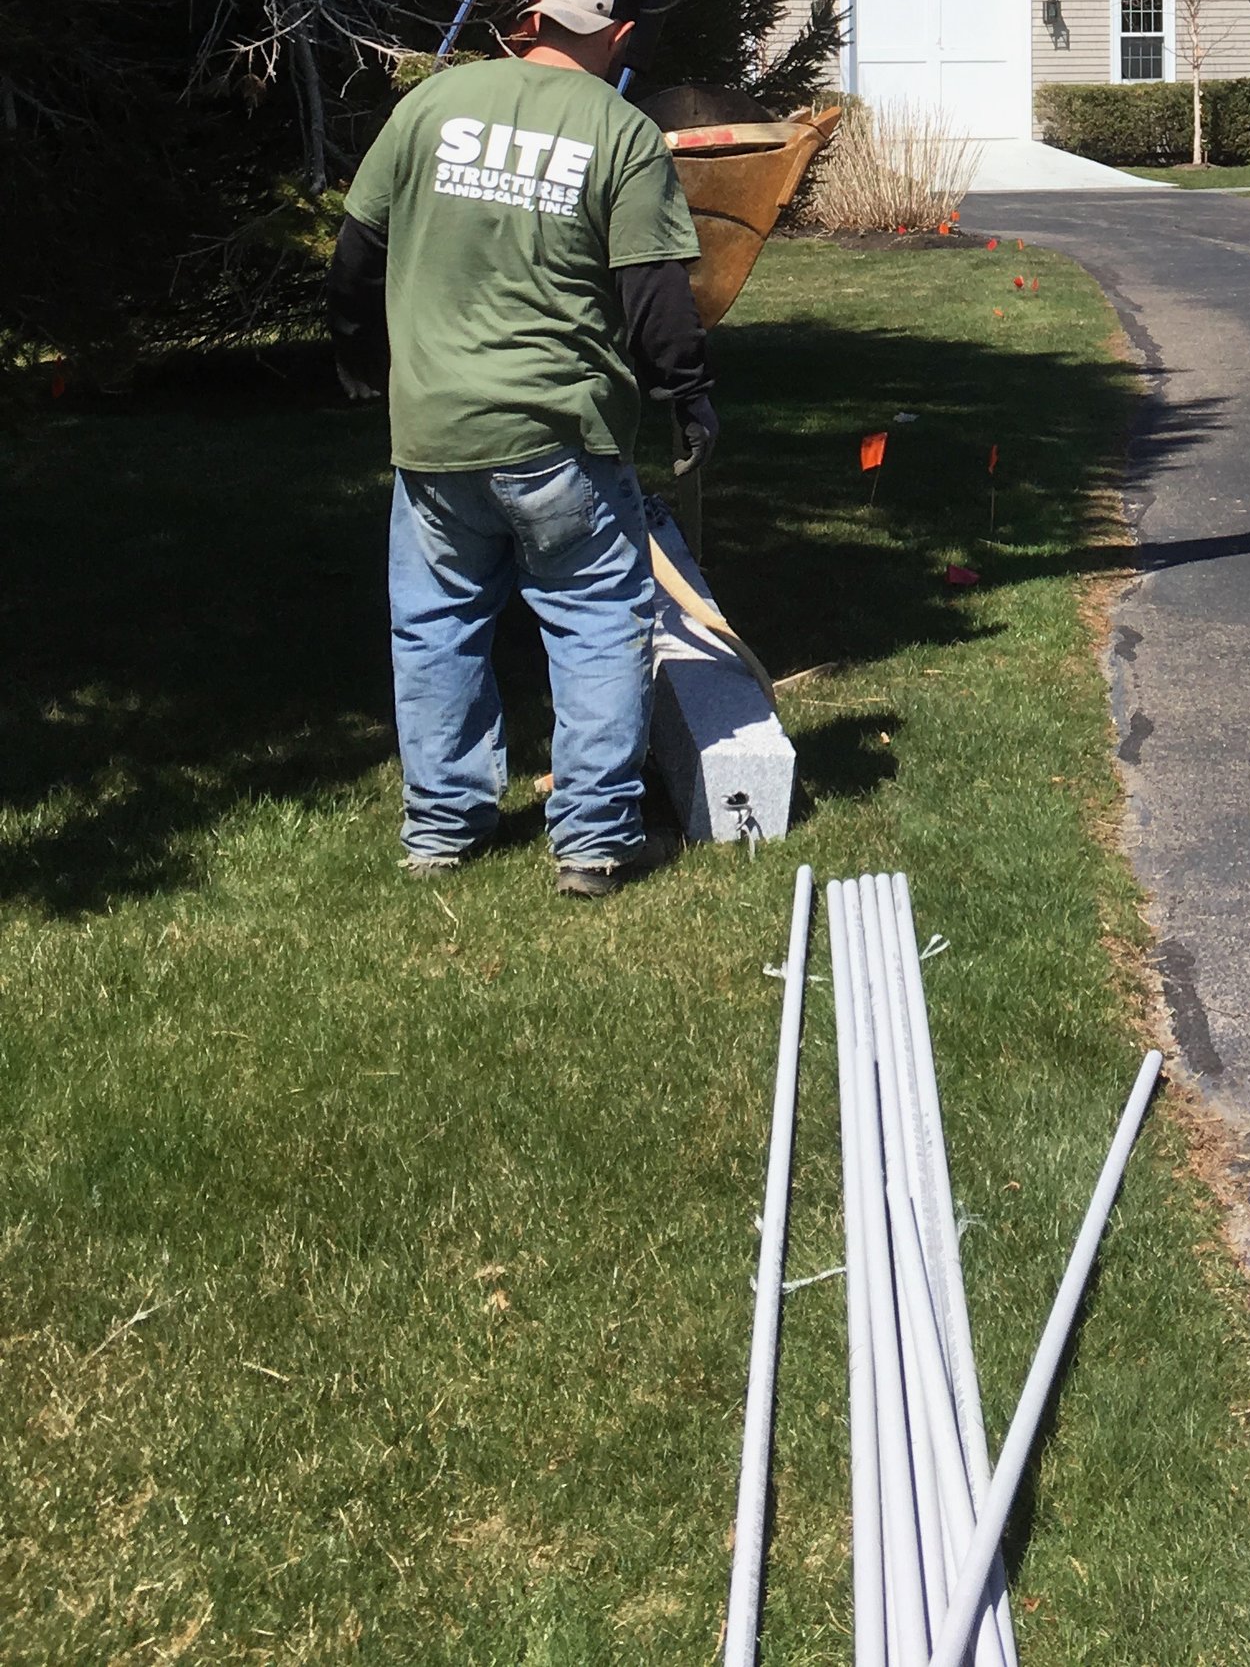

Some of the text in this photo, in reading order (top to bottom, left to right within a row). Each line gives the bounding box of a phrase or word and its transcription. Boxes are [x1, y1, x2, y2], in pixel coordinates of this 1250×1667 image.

[435, 117, 594, 188] SITE
[436, 162, 580, 205] STRUCTURES
[538, 199, 579, 217] INC.
